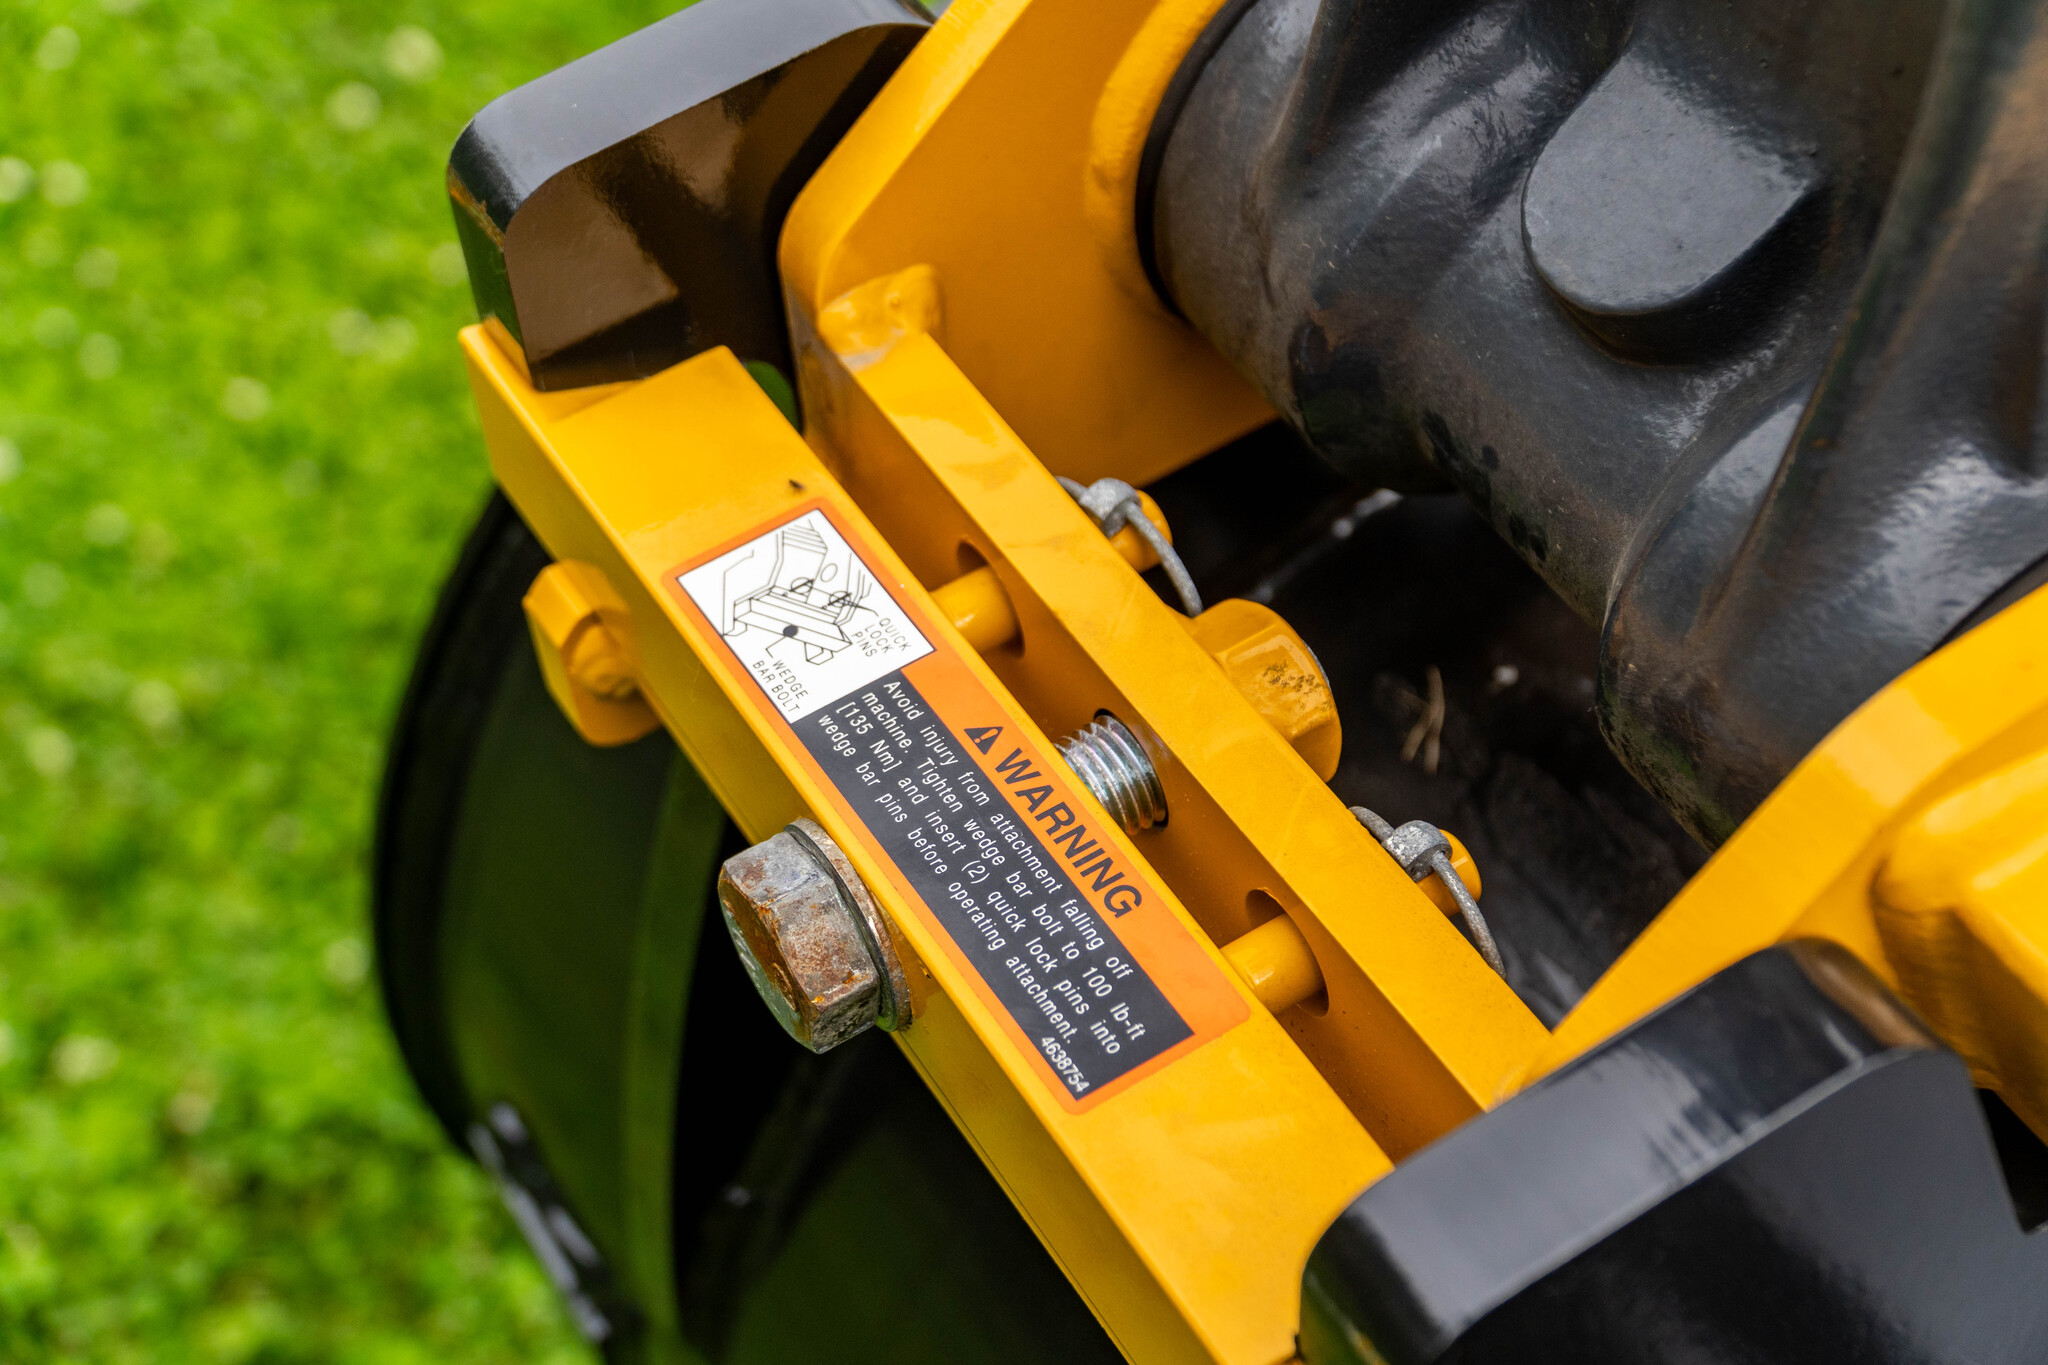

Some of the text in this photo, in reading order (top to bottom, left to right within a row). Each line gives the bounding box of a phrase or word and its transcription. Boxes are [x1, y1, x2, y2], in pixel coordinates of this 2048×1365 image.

[850, 630, 878, 658] PINS
[863, 624, 894, 654] LOCK
[878, 616, 911, 652] QUICK
[751, 659, 800, 712] BAR BOLT
[772, 659, 809, 700] WEDGE
[882, 681, 1134, 979] Avoid injury from attachment falling off
[994, 746, 1143, 919] WARNING
[818, 714, 1078, 1044] wedge bar pins before operating attachment.
[835, 700, 1121, 1054] [135 Nm] and insert (2) quick lock pins into
[861, 691, 1146, 1041] machine. Tighten wedge bar bolt to 100 lb-ft
[1041, 1036, 1090, 1092] 4638754
